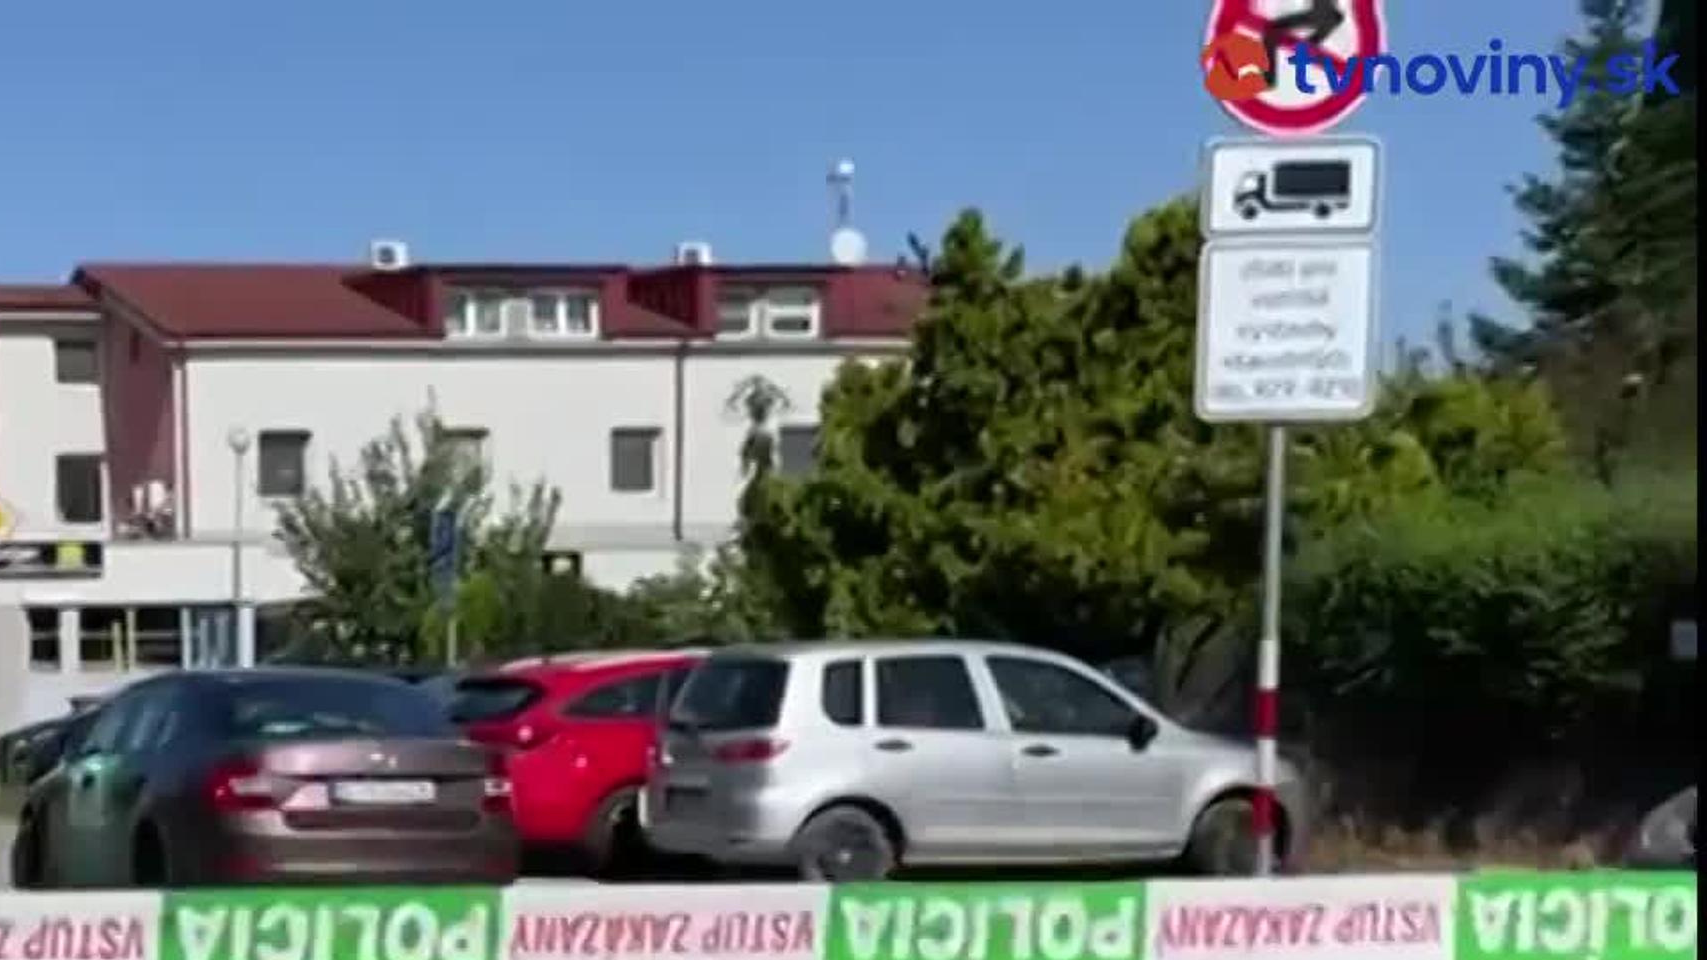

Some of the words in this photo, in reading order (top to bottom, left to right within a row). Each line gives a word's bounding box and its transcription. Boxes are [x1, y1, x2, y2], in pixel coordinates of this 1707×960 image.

[23, 916, 143, 960] VSTUP
[702, 910, 815, 955] VSTUP
[1157, 904, 1324, 957] ZAKÁZANÝ
[1336, 901, 1441, 944] VSTUP
